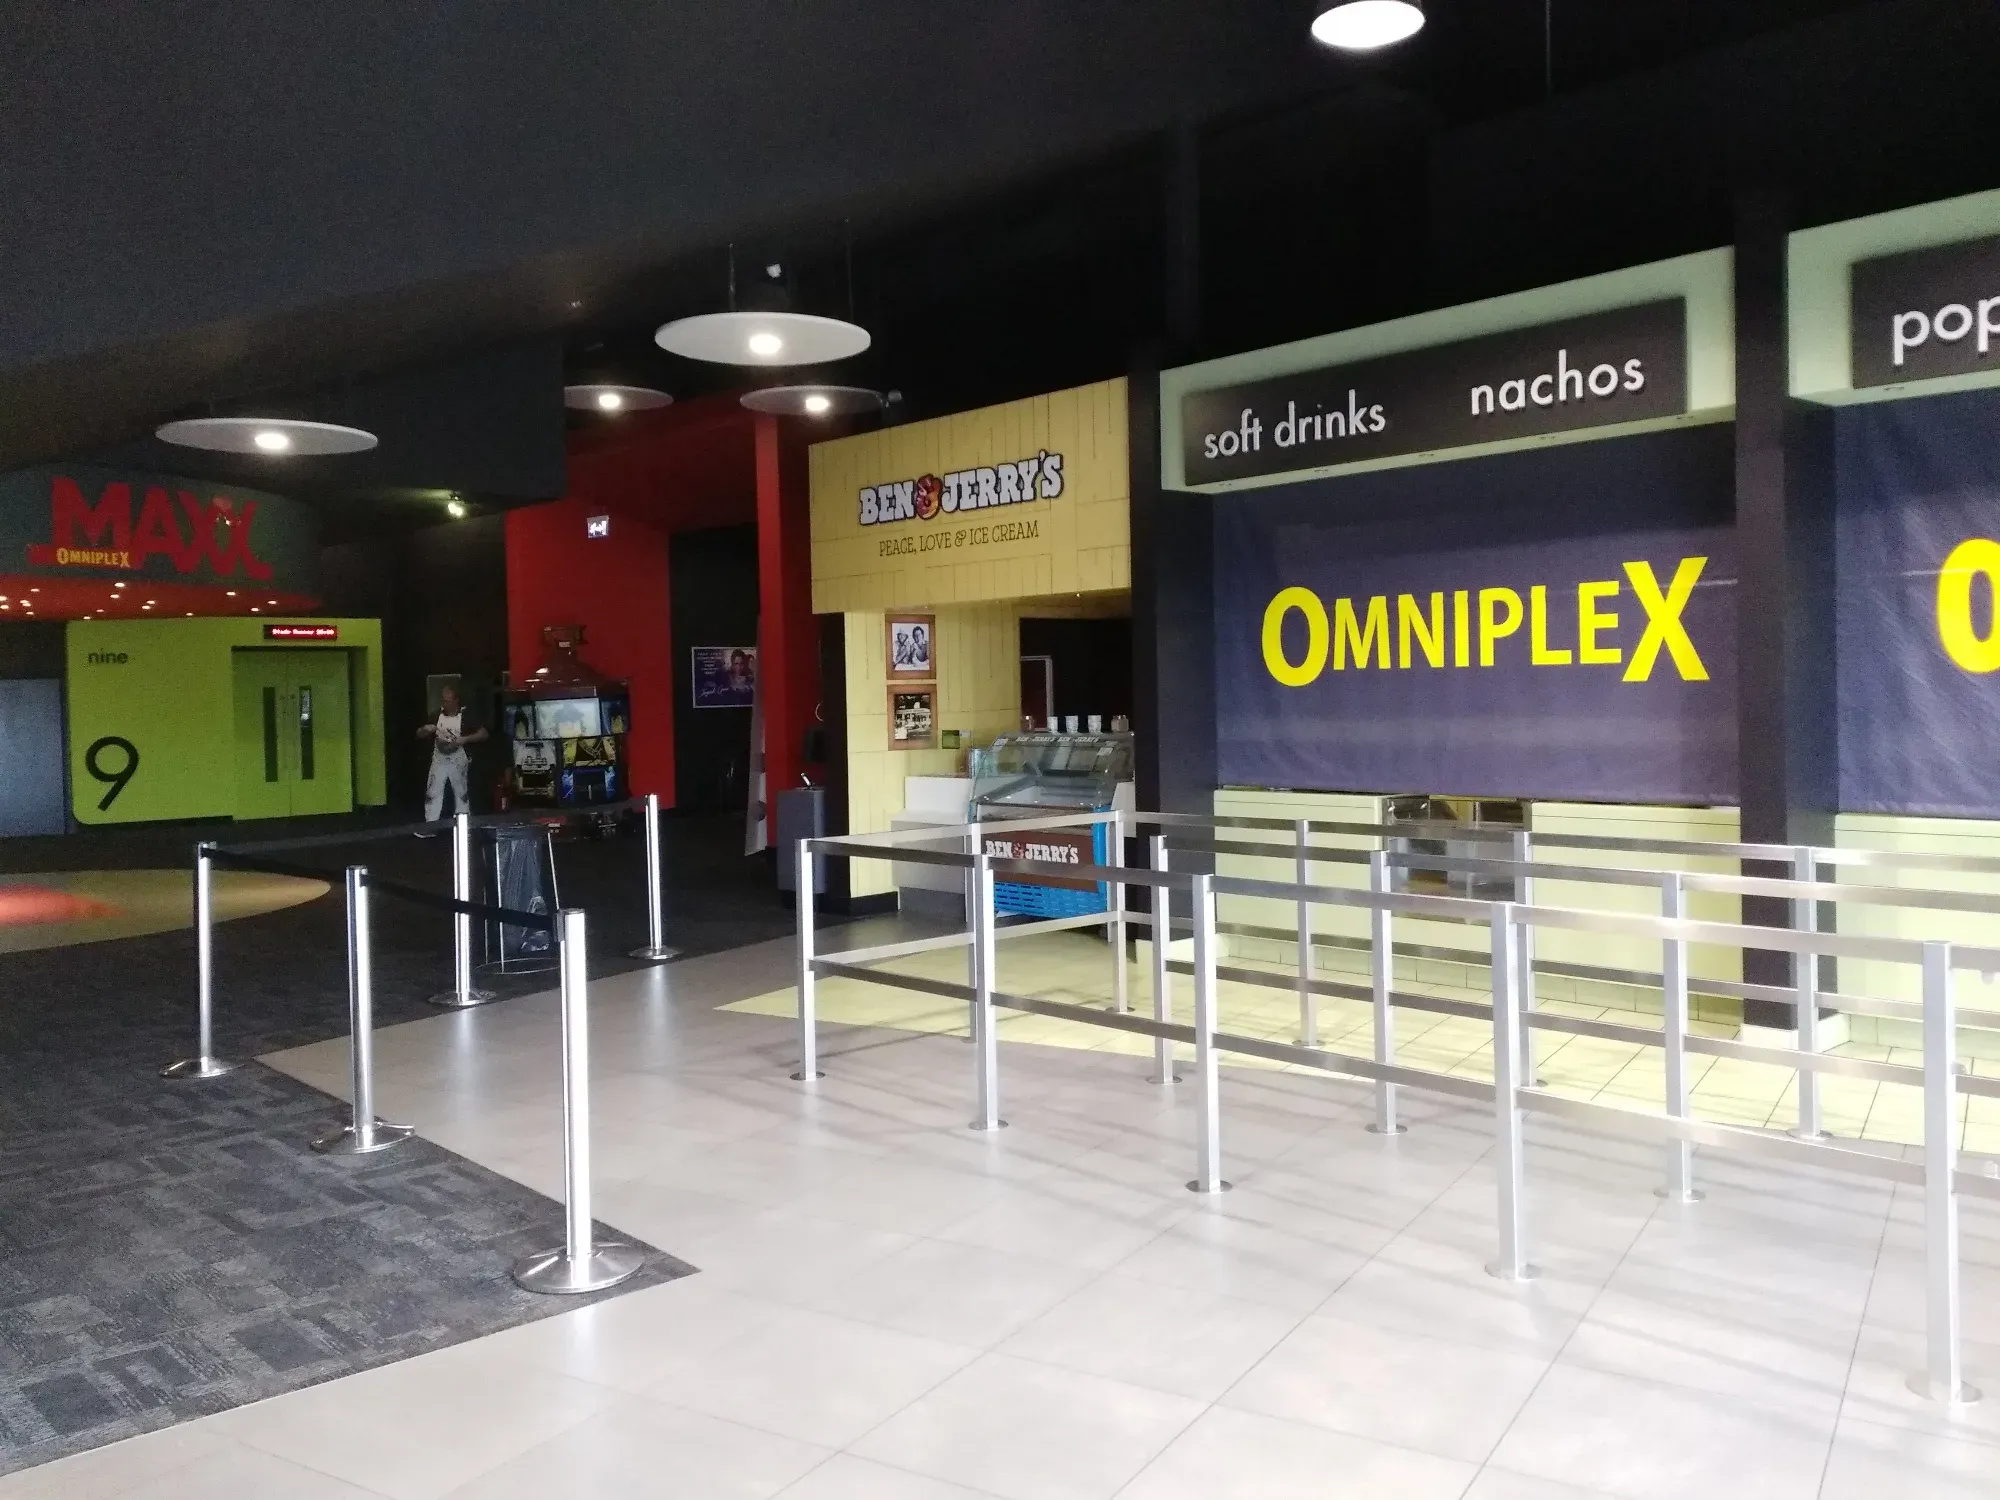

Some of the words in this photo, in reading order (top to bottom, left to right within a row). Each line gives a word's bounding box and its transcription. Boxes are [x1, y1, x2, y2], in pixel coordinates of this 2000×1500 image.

[1471, 349, 1645, 416] nachos
[1204, 408, 1262, 459] soft
[1274, 389, 1386, 447] drinks
[860, 480, 916, 526] BEN
[941, 449, 1064, 513] JERRY'S
[28, 477, 273, 582] MAXX
[56, 547, 130, 568] OMNIPLEX
[878, 536, 917, 557] PEACE,
[919, 531, 952, 552] LOVE
[954, 529, 967, 548] &
[969, 526, 989, 546] ICE
[991, 520, 1039, 543] CREAM
[1261, 556, 1710, 688] OMNIPLEX
[88, 648, 129, 665] nine
[85, 736, 140, 812] 9
[985, 840, 1013, 858] BEN
[1025, 843, 1079, 864] JERRY'S
